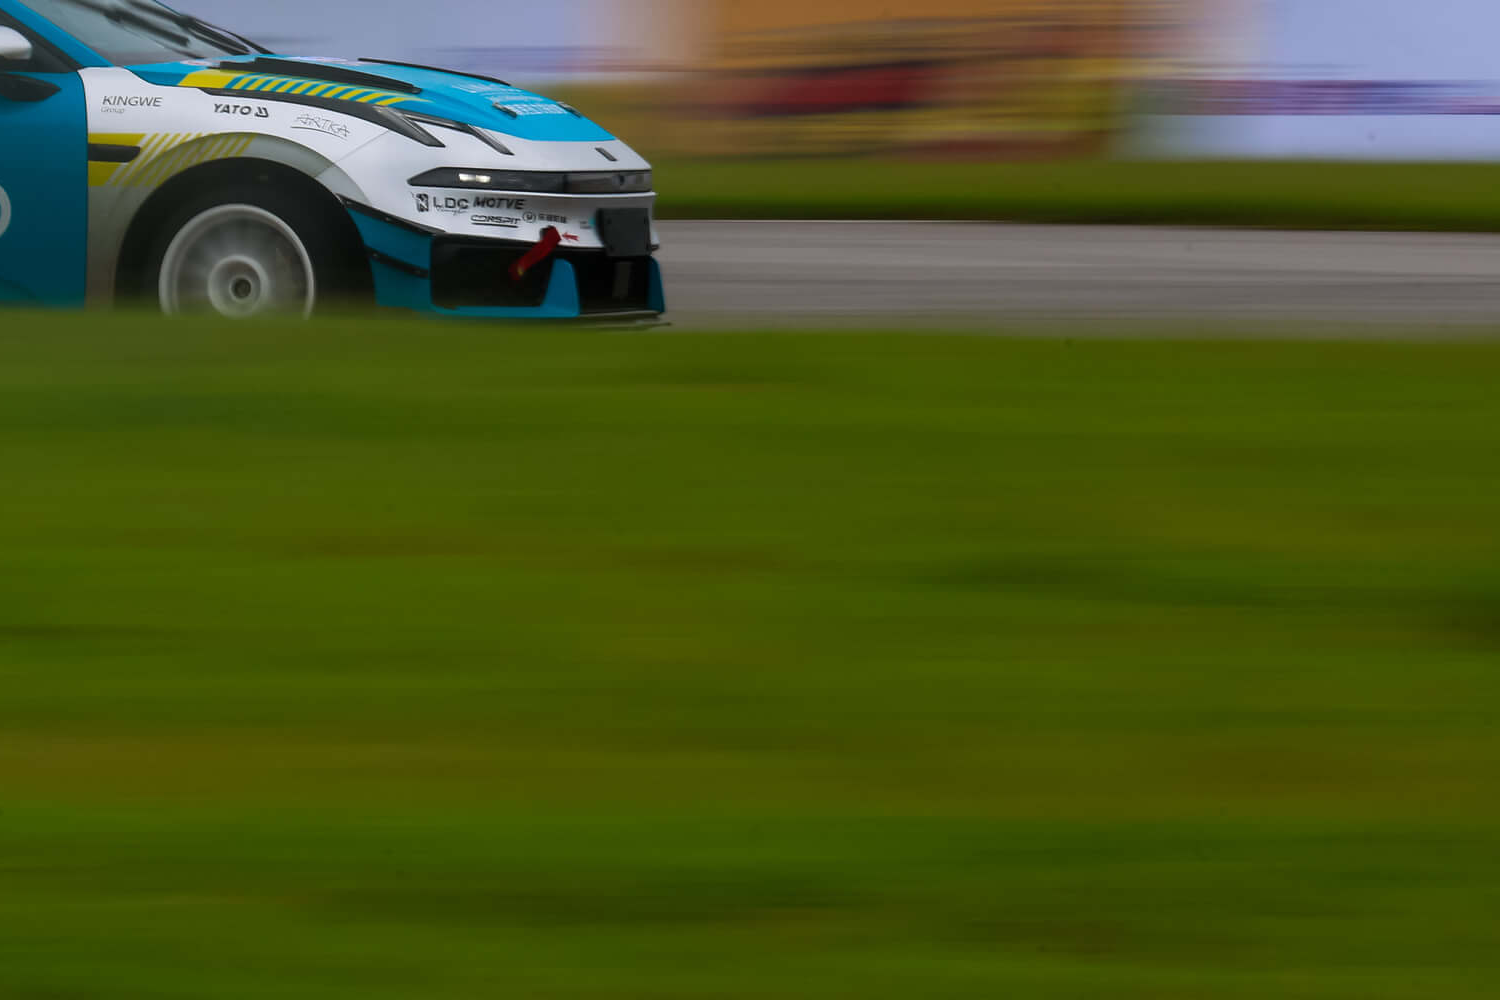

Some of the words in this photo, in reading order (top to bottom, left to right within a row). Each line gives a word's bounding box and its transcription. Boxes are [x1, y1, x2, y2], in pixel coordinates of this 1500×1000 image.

[102, 95, 163, 107] KINGWE
[213, 103, 252, 116] YATO
[433, 196, 469, 210] LDC
